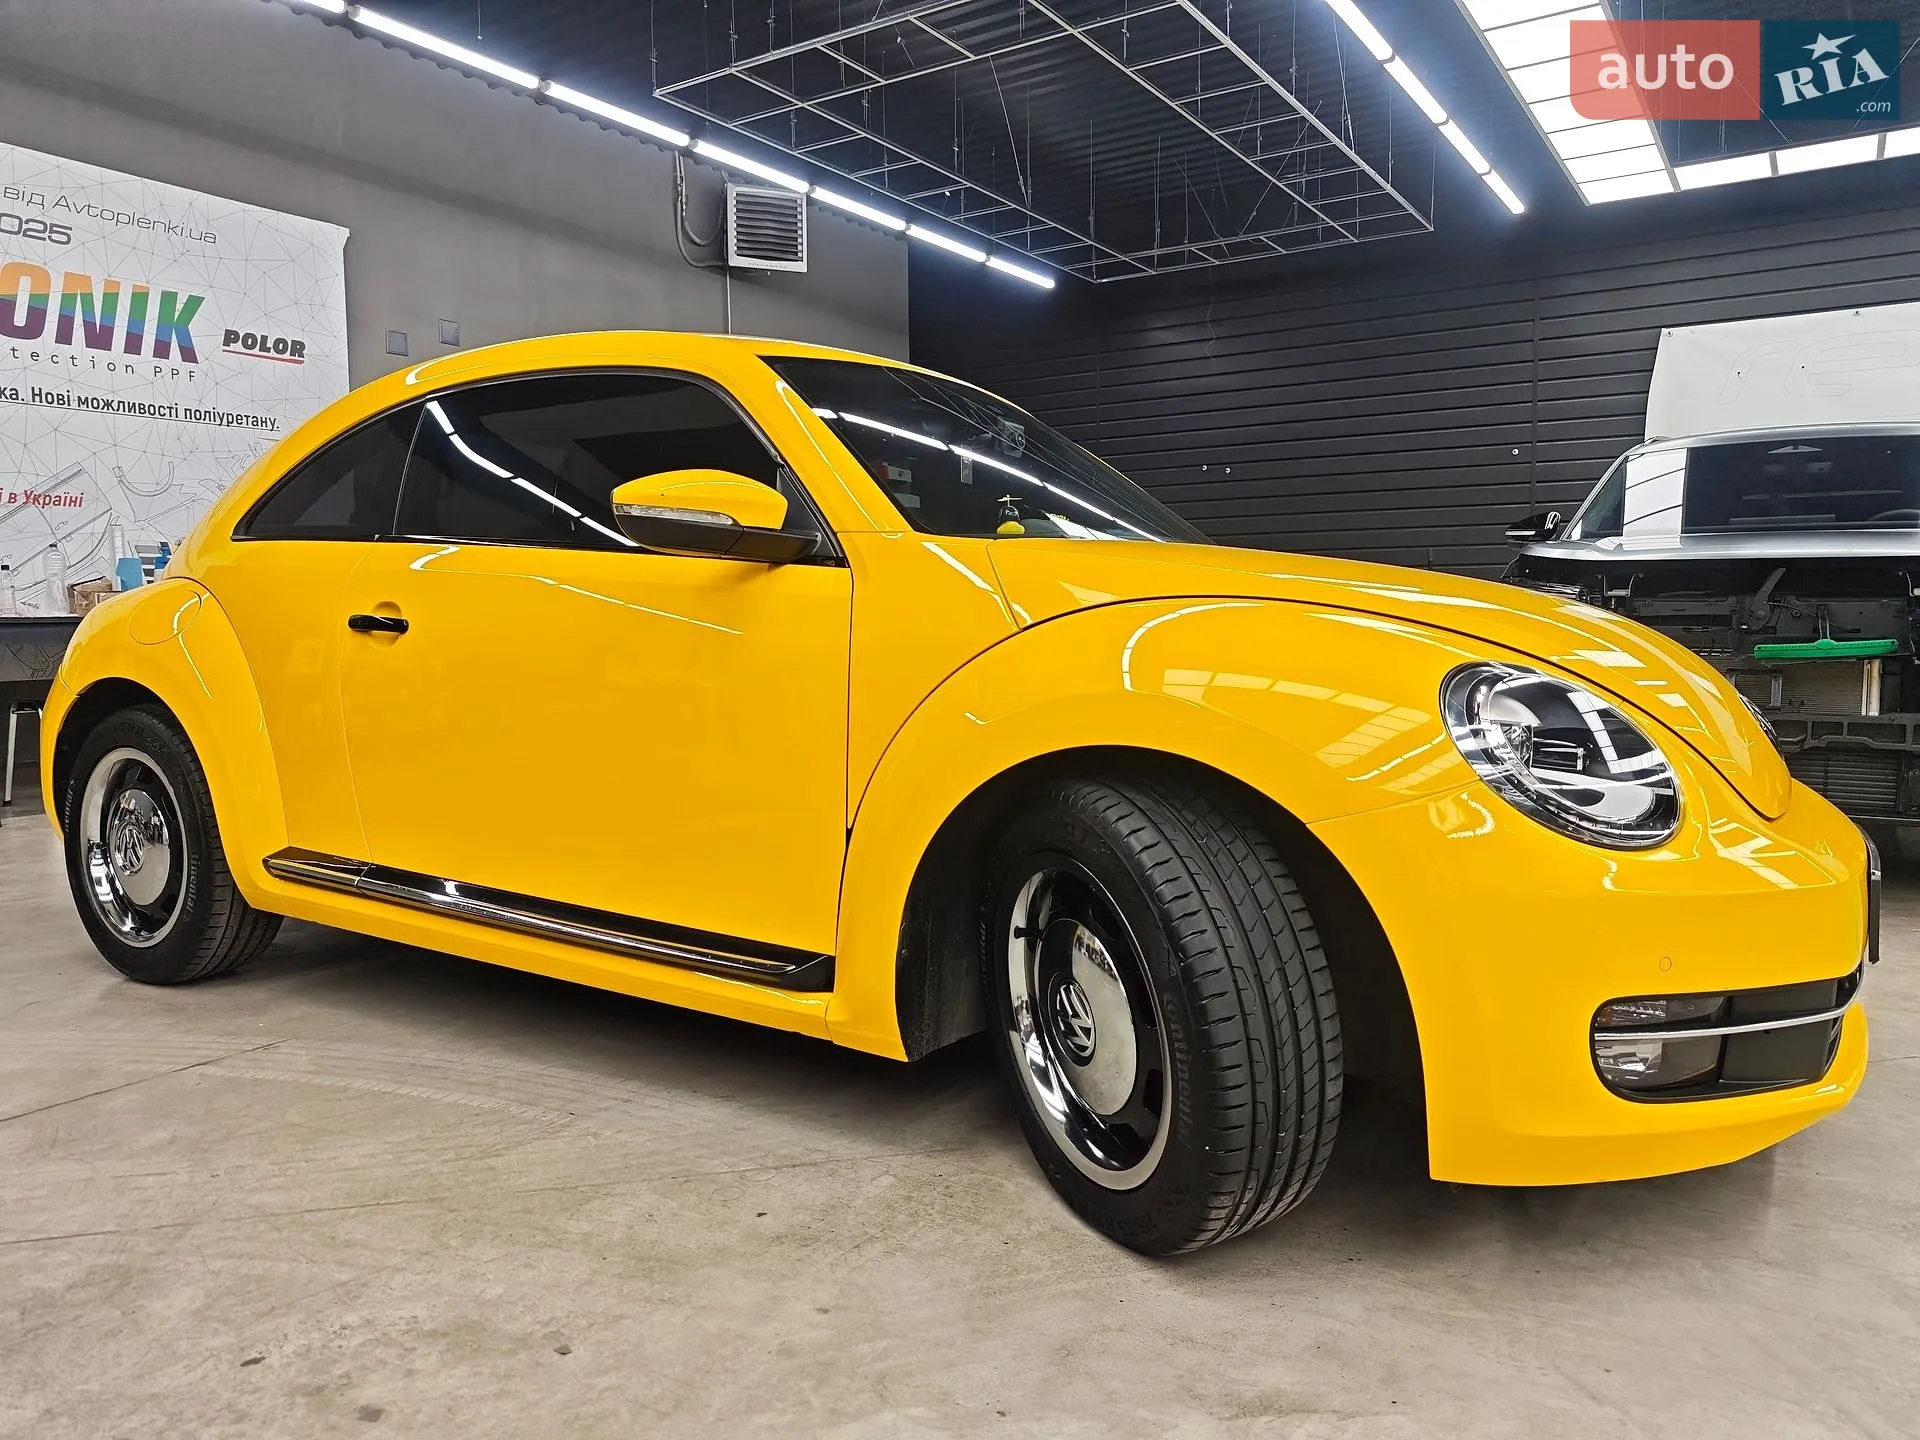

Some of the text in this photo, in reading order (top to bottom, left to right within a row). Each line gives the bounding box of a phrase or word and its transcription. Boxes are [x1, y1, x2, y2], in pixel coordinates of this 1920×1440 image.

[0, 212, 73, 246] 025
[3, 186, 217, 244] від Avtoplenki.ua
[0, 261, 206, 365] ONIK
[222, 328, 306, 358] POLOR
[9, 345, 196, 383] tection PPF
[31, 386, 72, 407] Нові
[77, 395, 178, 419] можливості
[184, 406, 280, 432] поліуретану.
[7, 492, 18, 504] в
[24, 489, 84, 509] Україні
